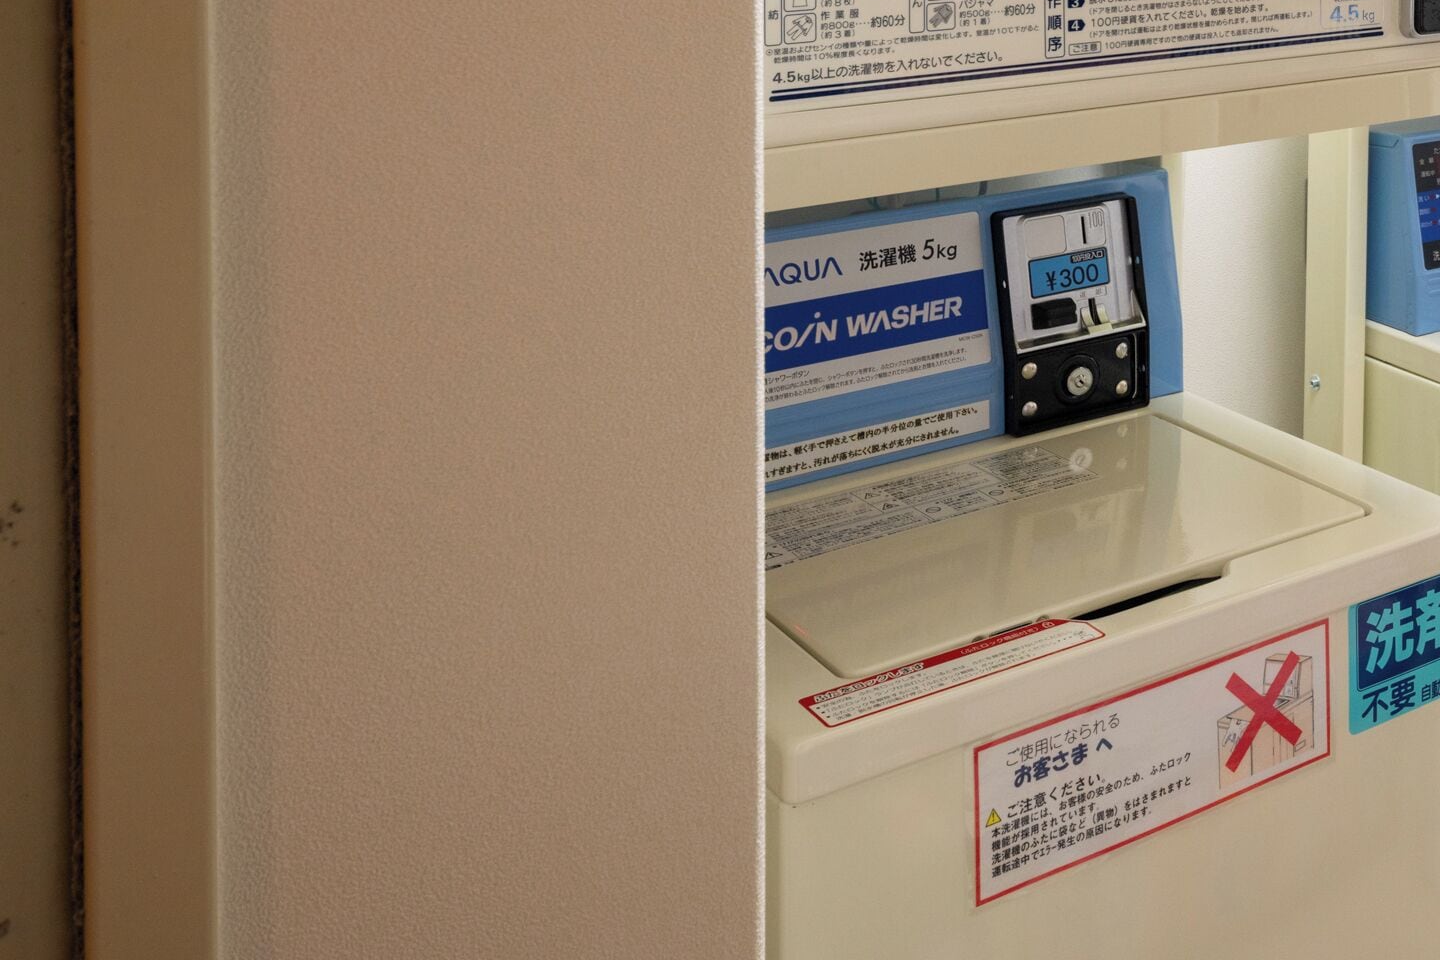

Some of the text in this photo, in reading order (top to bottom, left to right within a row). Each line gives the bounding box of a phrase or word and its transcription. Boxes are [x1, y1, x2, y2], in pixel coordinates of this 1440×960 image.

[871, 15, 905, 28] 約60分
[1004, 4, 1036, 17] 約60分
[1330, 4, 1375, 24] 4.5 kg
[1072, 44, 1098, 54] ご注意
[1088, 211, 1104, 228] 100
[859, 244, 916, 272] 洗濯機
[922, 238, 958, 261] 5kg
[1046, 264, 1099, 291] ¥300
[846, 296, 963, 337] WASHER
[1362, 675, 1416, 723] 不要
[1006, 713, 1121, 767] ご使用になられる
[1007, 773, 1107, 819] ご注意ください。
